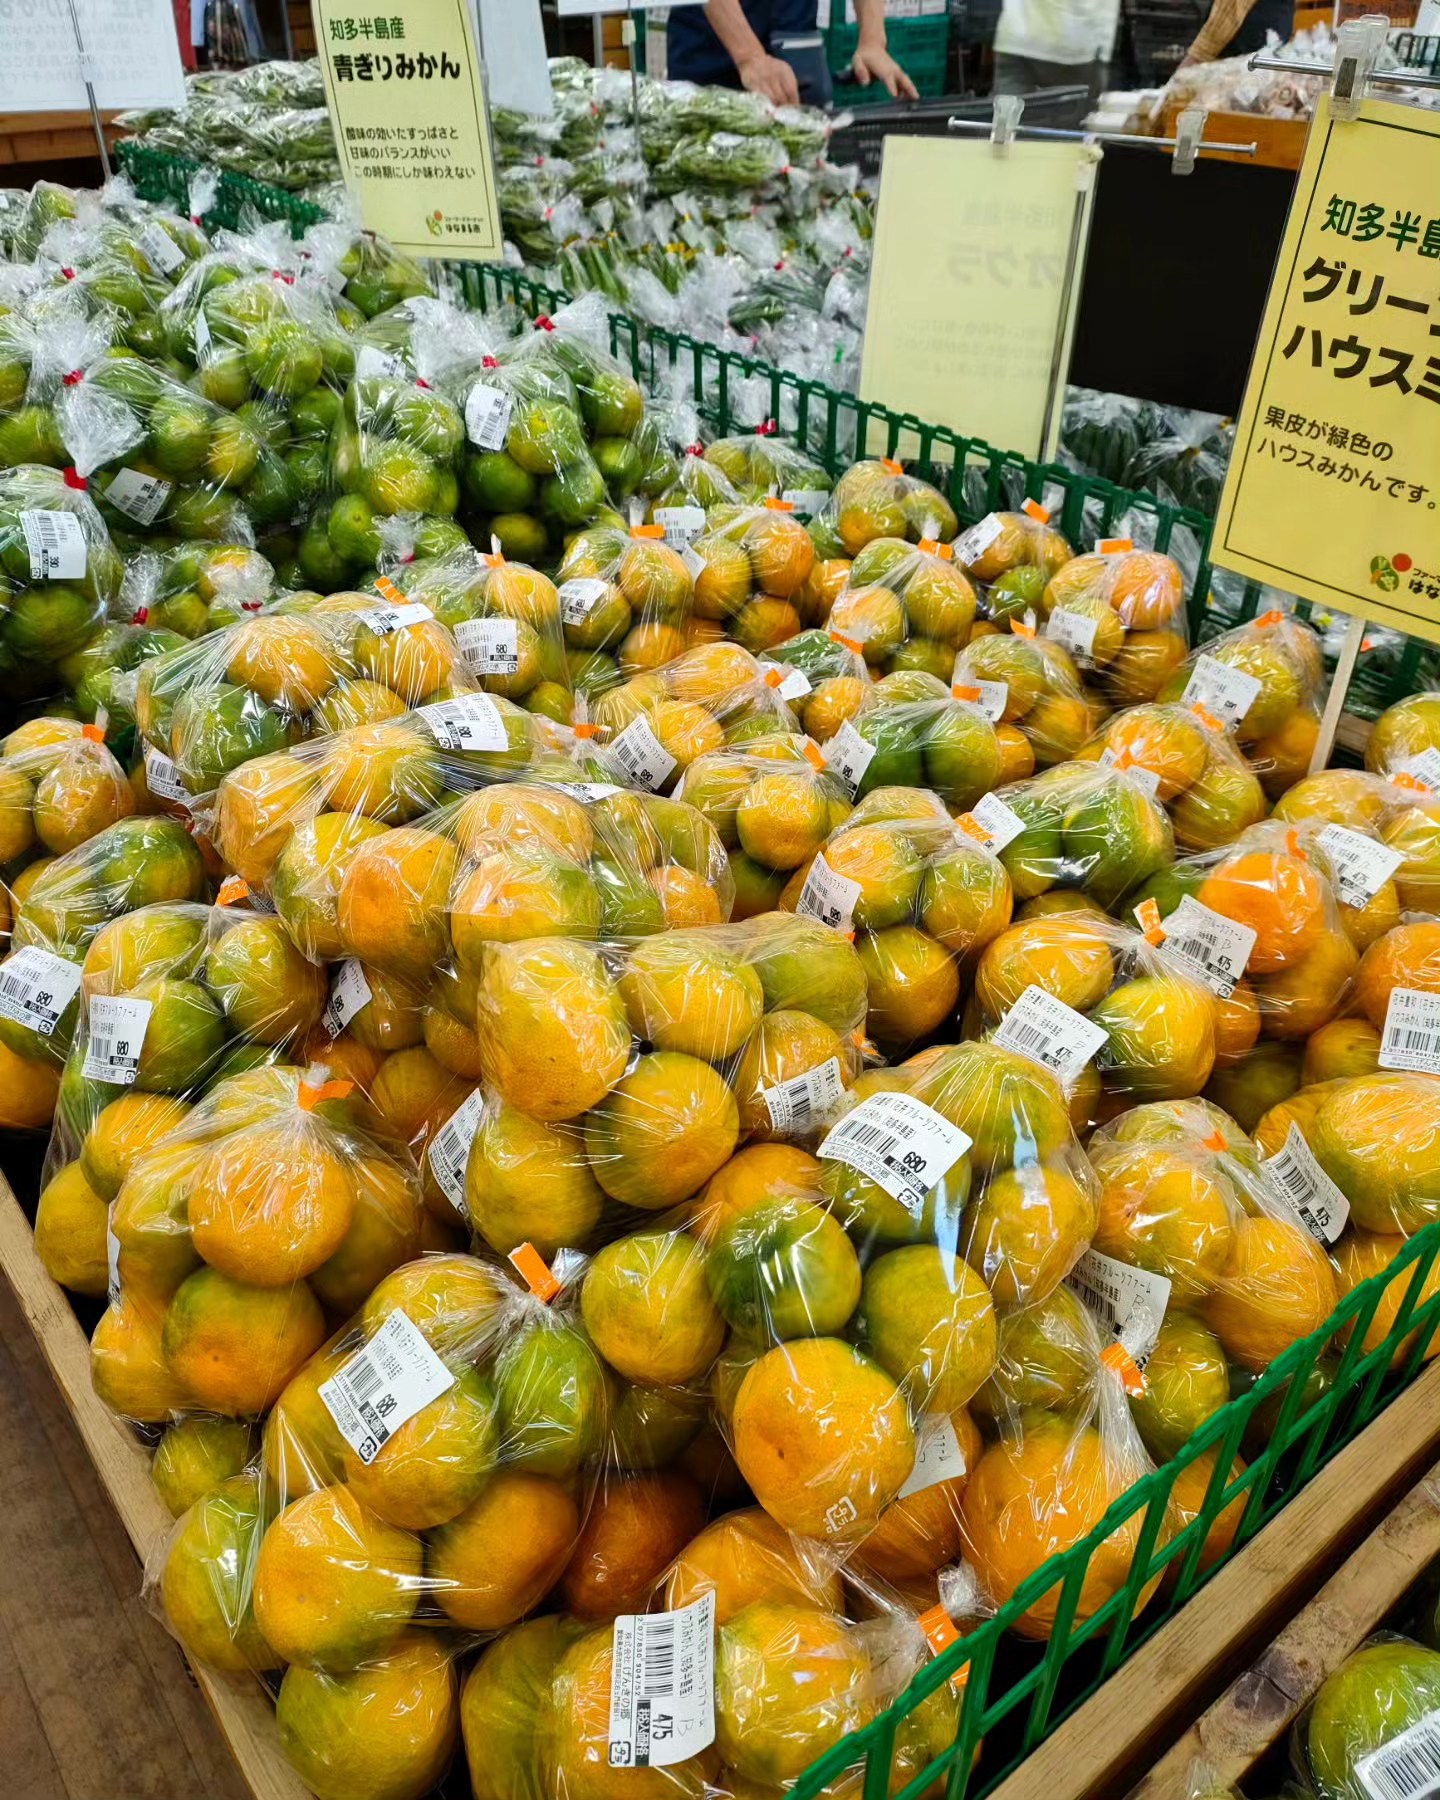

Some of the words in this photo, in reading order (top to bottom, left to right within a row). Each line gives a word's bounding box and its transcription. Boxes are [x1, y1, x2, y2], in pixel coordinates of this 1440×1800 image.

[330, 17, 405, 41] 知多半島産
[333, 52, 461, 82] 青ぎりみかん
[345, 126, 459, 141] 酸味の効いたすっぱさと
[349, 146, 451, 160] 甘味のバランスがいい
[354, 165, 476, 179] この時期にしか味わえない
[1303, 256, 1440, 336] グリー
[1264, 405, 1394, 462] 果皮が緑色の
[1257, 437, 1436, 510] ハウスみかんです。
[496, 644, 507, 654] 680
[641, 769, 653, 782] 680
[1217, 955, 1232, 971] 475
[36, 991, 53, 1006] 680
[116, 1041, 129, 1056] 680
[902, 1151, 927, 1173] 680
[1316, 1206, 1333, 1227] 475
[376, 1394, 398, 1418] 680
[637, 1626, 645, 1659] 077830
[634, 1662, 642, 1697] 904752
[621, 1665, 632, 1720] げんきの郷
[636, 1706, 651, 1757] 税込価格
[652, 1713, 674, 1740] 475
